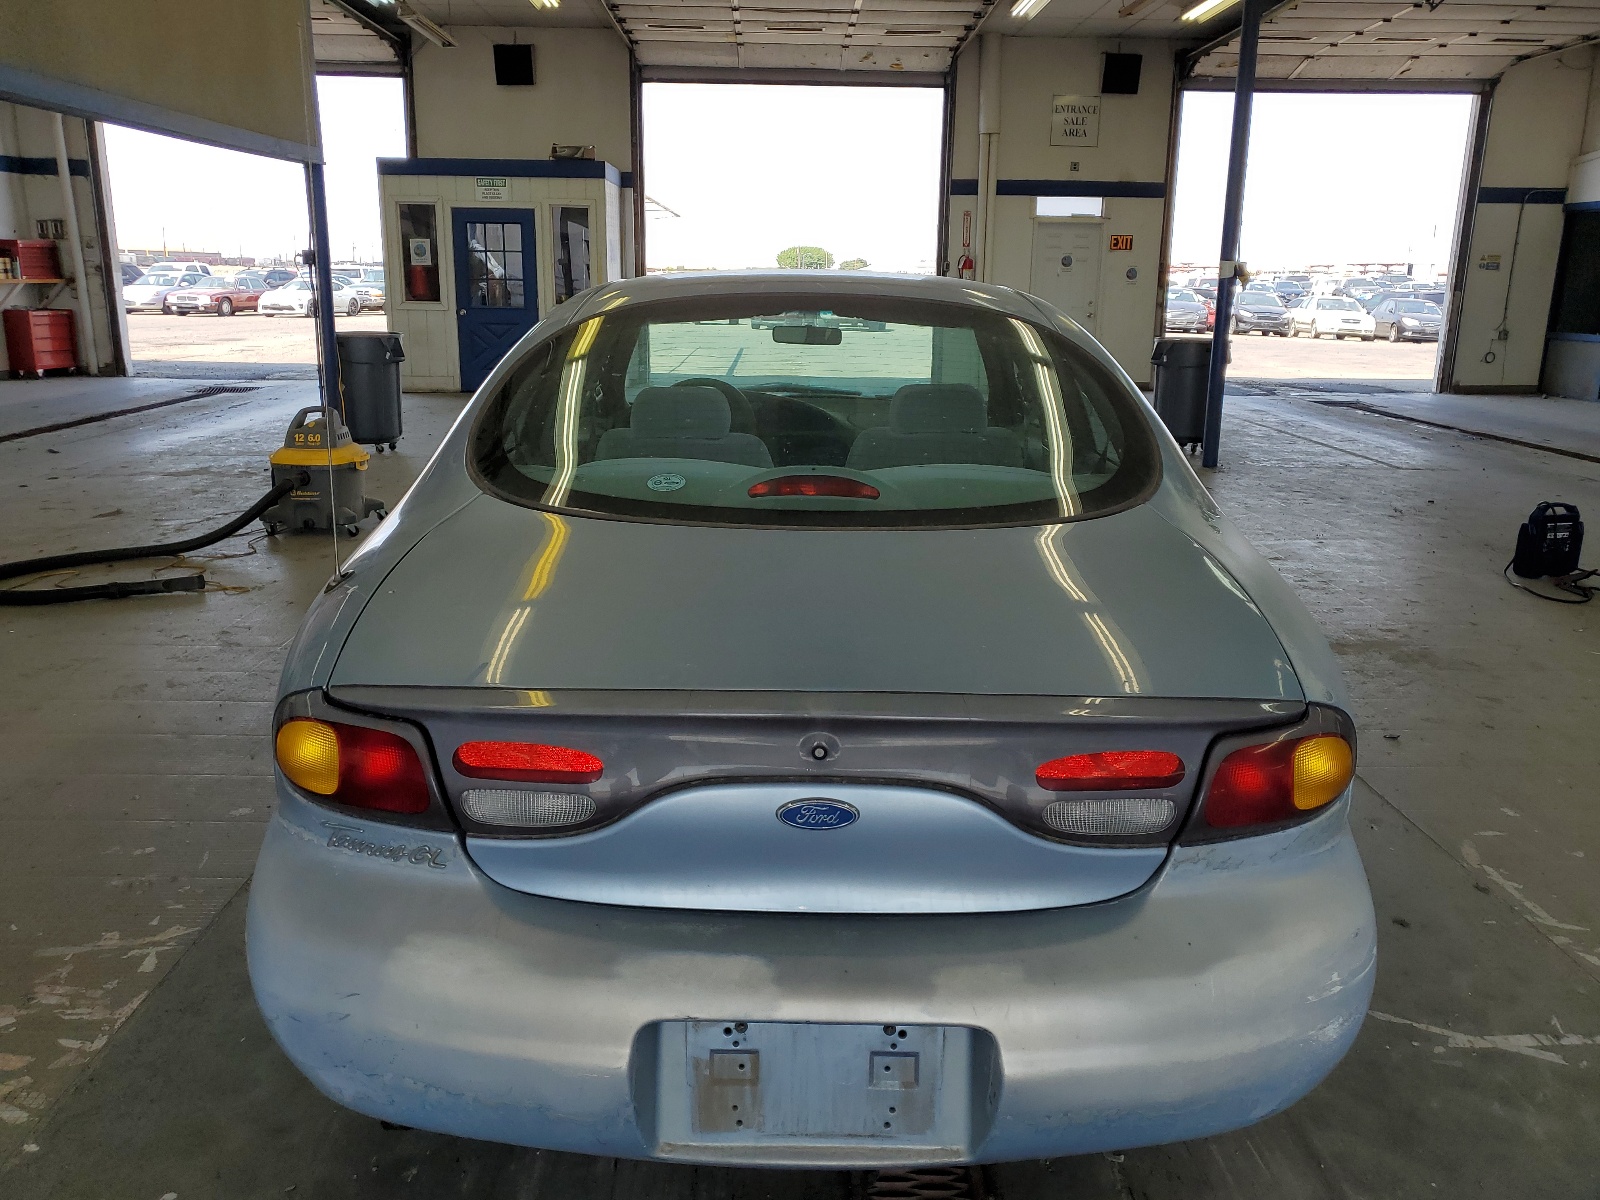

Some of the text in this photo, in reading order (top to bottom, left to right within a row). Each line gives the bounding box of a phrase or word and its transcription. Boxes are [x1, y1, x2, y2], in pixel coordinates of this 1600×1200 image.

[1055, 104, 1098, 114] ENTRANCE
[1063, 116, 1087, 126] SALE
[1061, 128, 1087, 138] AREA
[477, 178, 506, 187] SAFETY FIRST
[1111, 235, 1133, 250] EXIT
[294, 433, 321, 442] 12 6.0
[796, 805, 841, 824] Ford
[407, 844, 447, 869] GL
